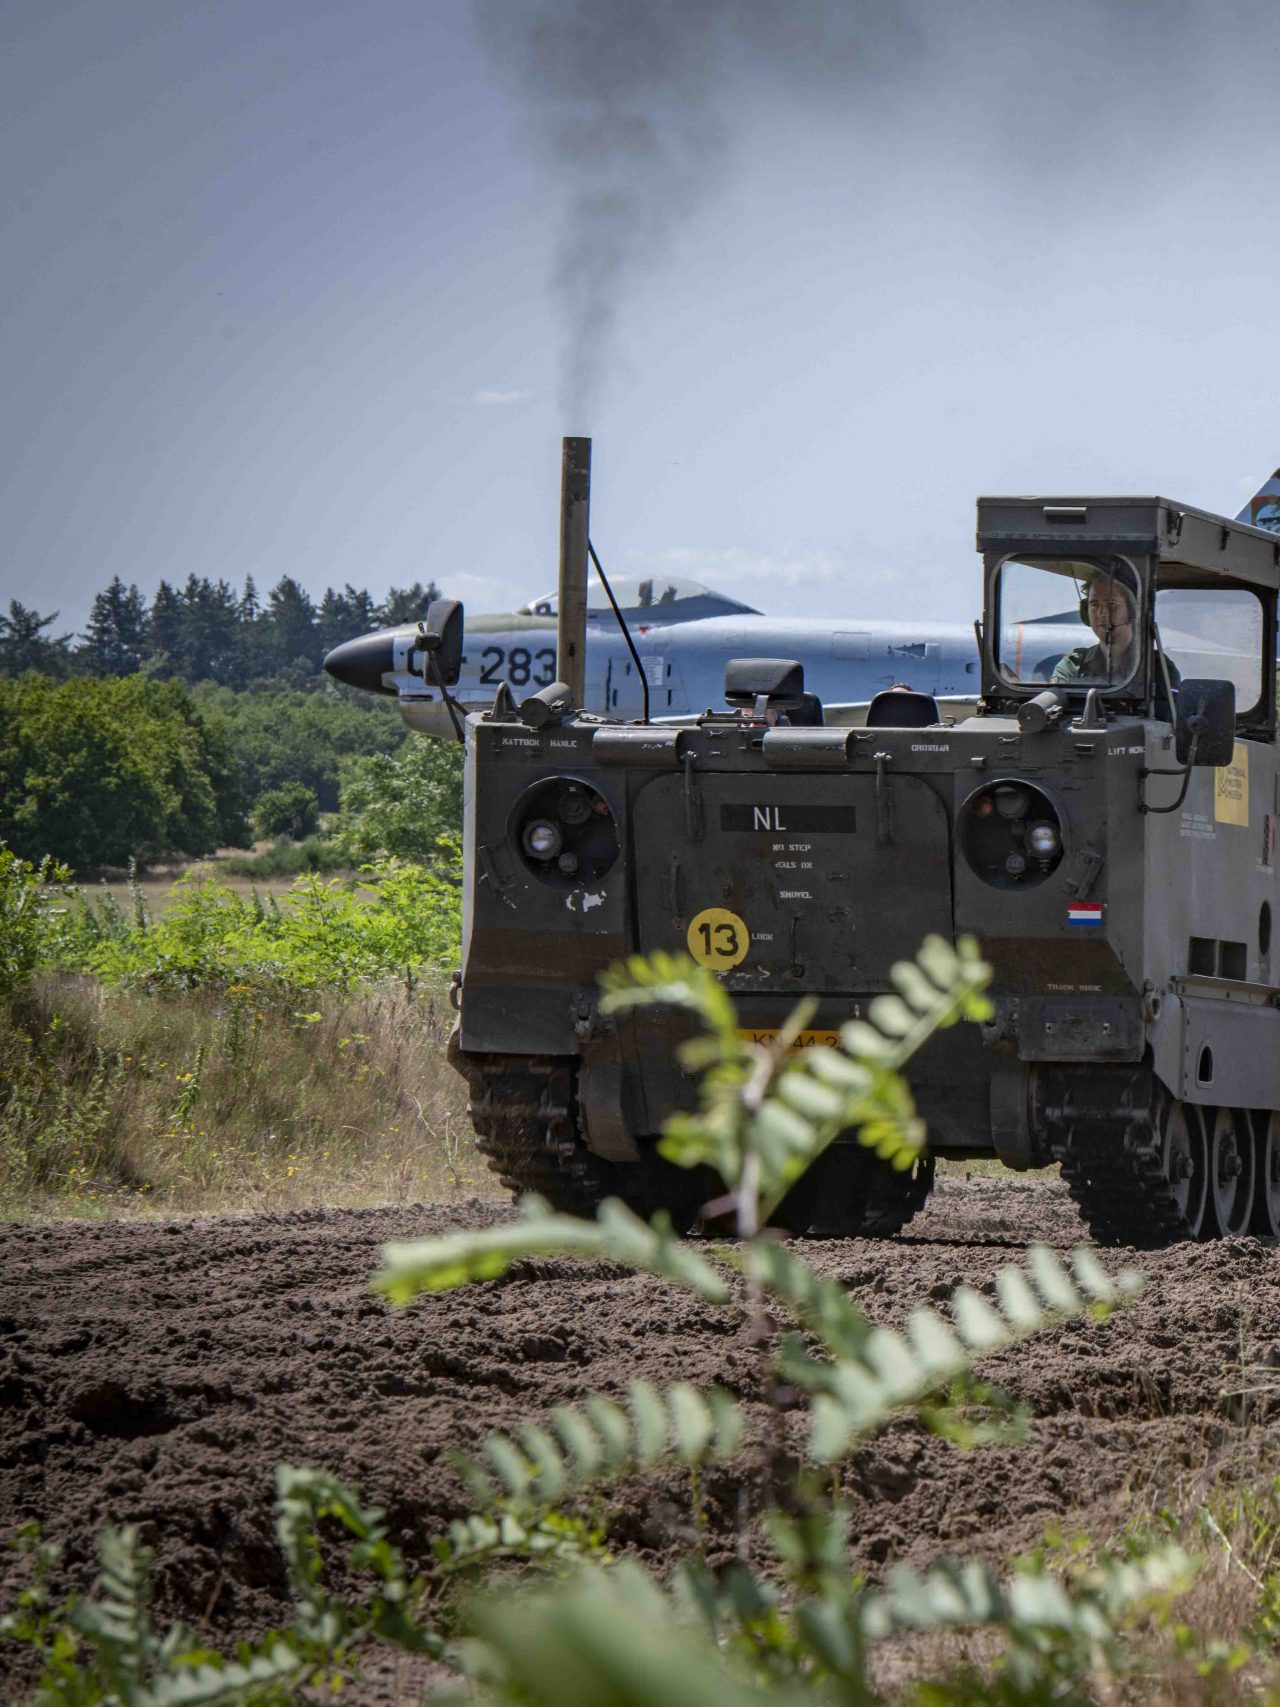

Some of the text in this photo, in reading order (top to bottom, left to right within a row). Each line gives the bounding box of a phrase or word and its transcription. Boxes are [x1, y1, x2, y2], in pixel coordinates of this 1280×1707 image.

[1108, 747, 1126, 756] LIFT
[754, 806, 787, 831] NL
[772, 844, 811, 852] NO STEP
[780, 891, 812, 899] SHOVEL
[698, 922, 739, 956] 13
[751, 932, 773, 941] LOCK
